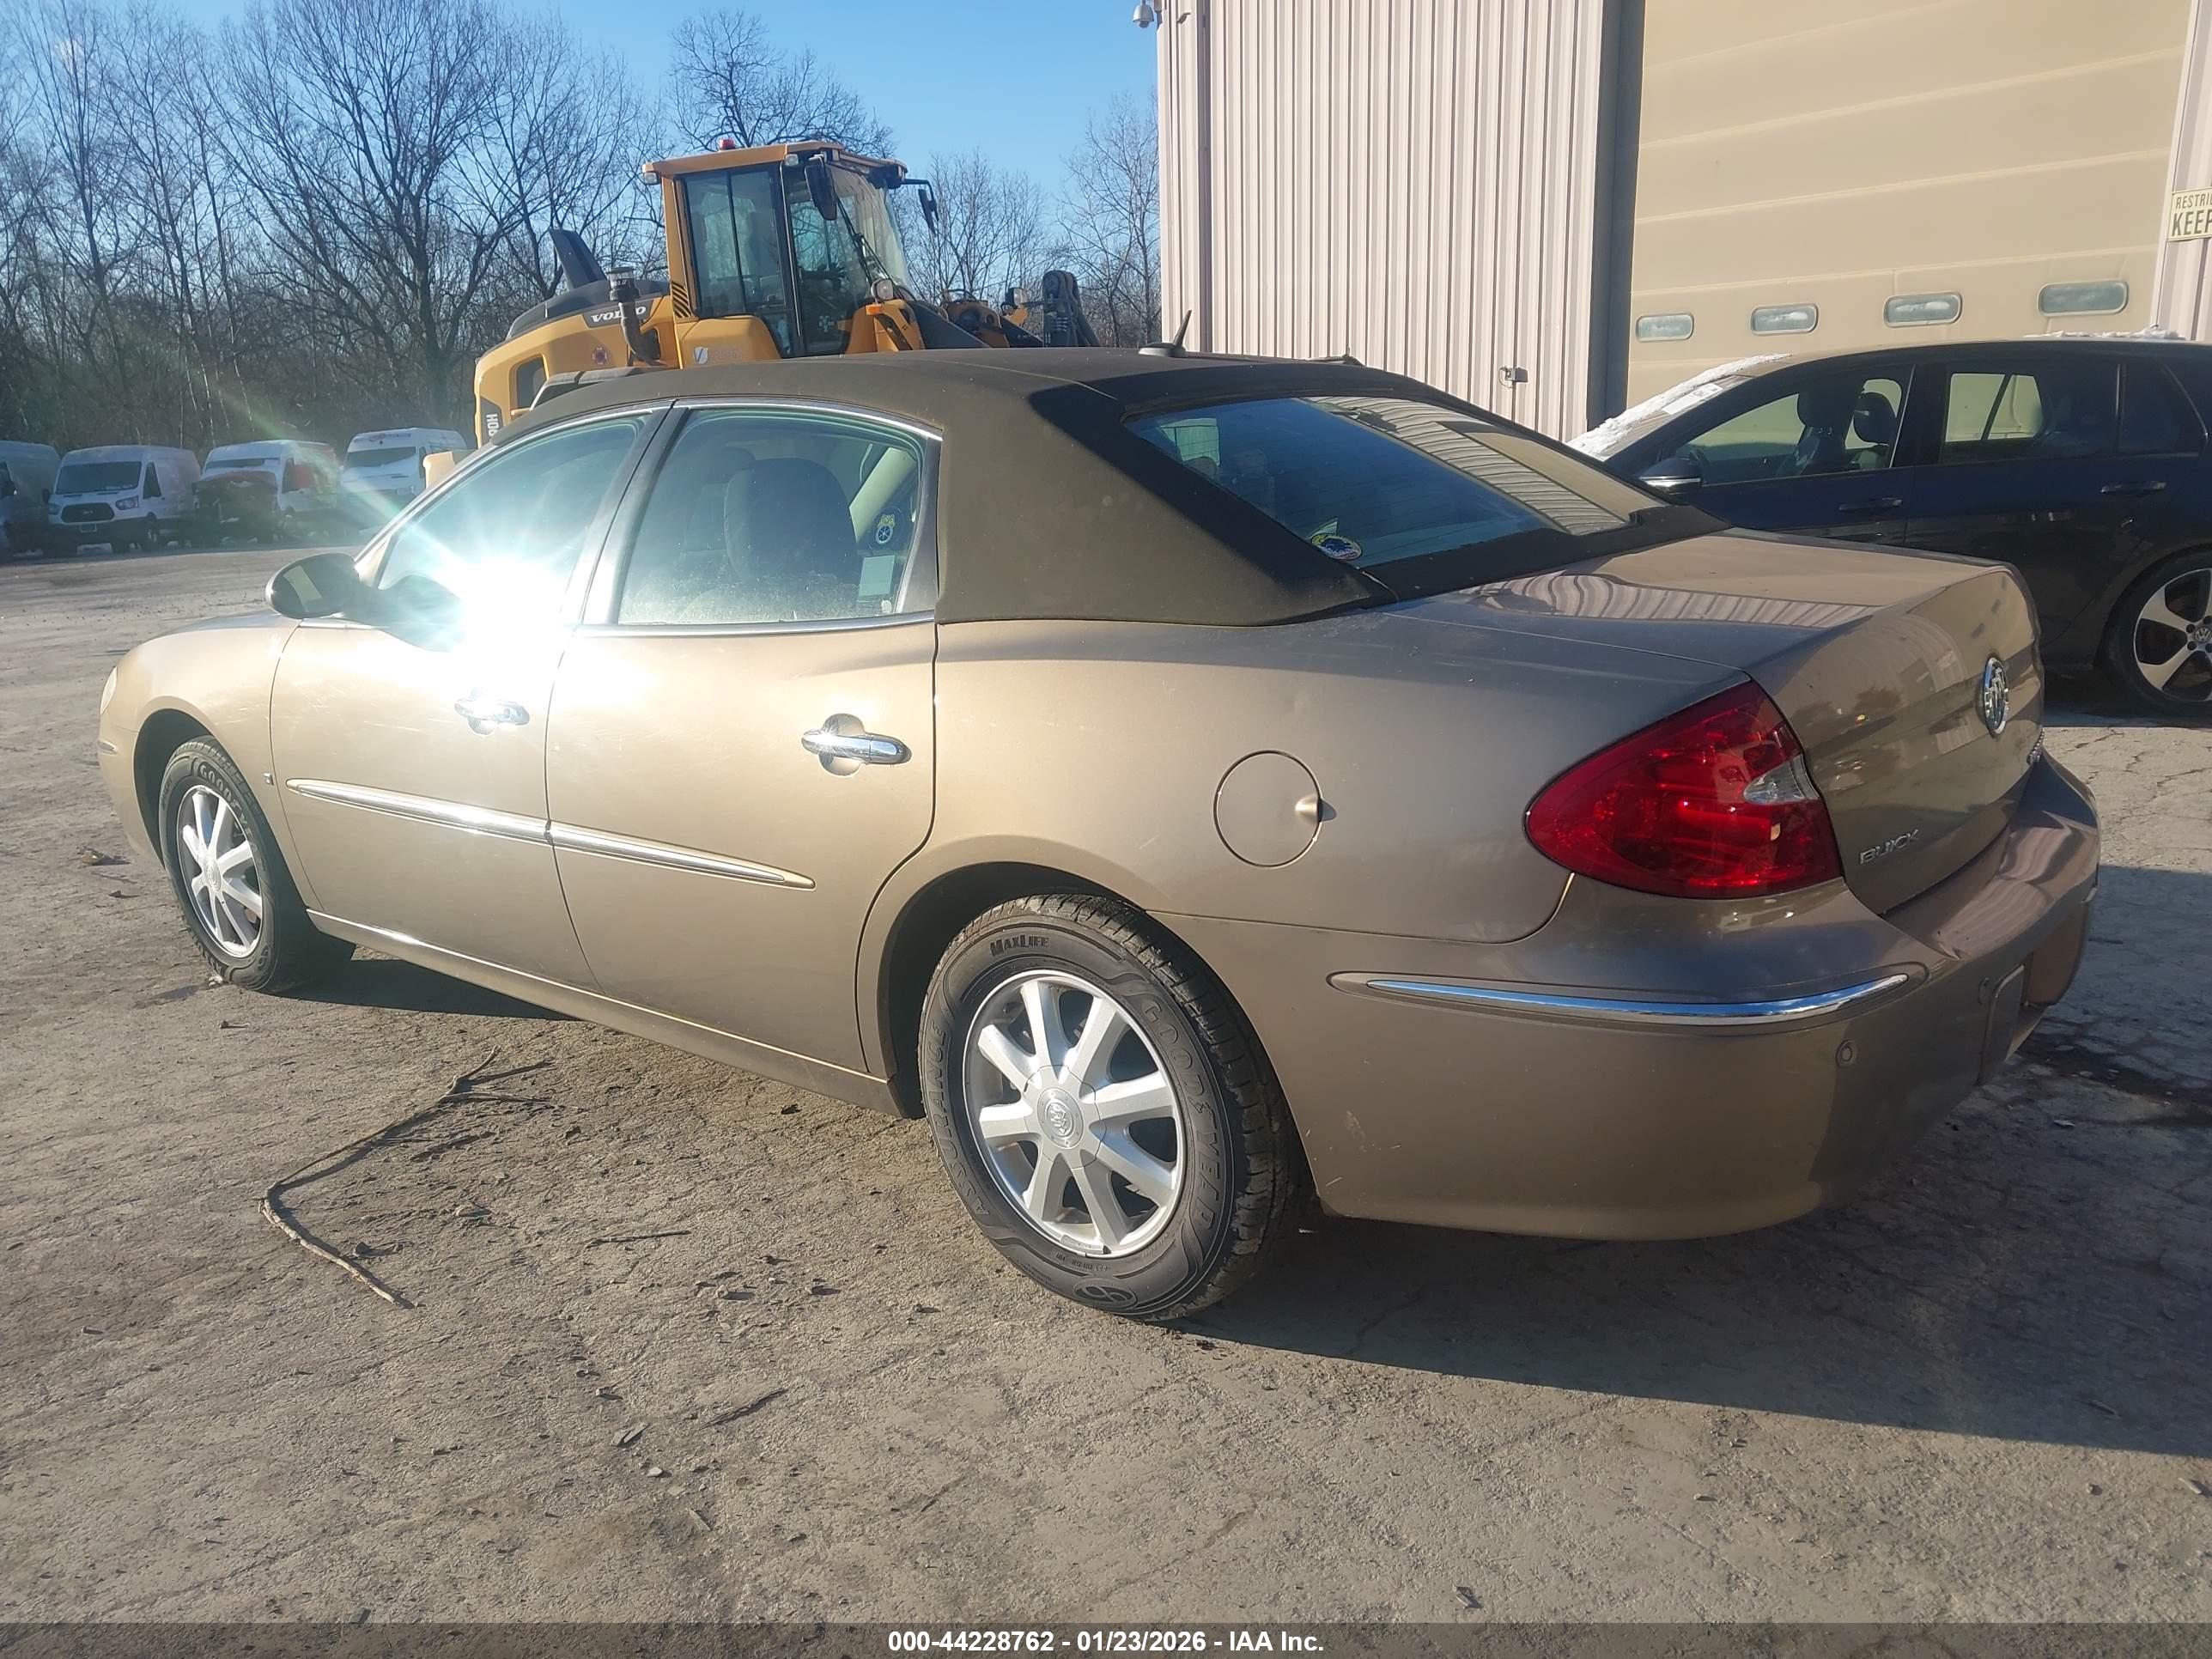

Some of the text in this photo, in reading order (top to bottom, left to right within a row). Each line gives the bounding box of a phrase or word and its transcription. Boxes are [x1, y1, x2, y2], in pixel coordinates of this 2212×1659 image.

[591, 307, 647, 323] VOLO
[1860, 829, 1919, 865] BUICK
[927, 1021, 990, 1216] ASSURANCE
[1141, 998, 1222, 1231] GOODYEAR
